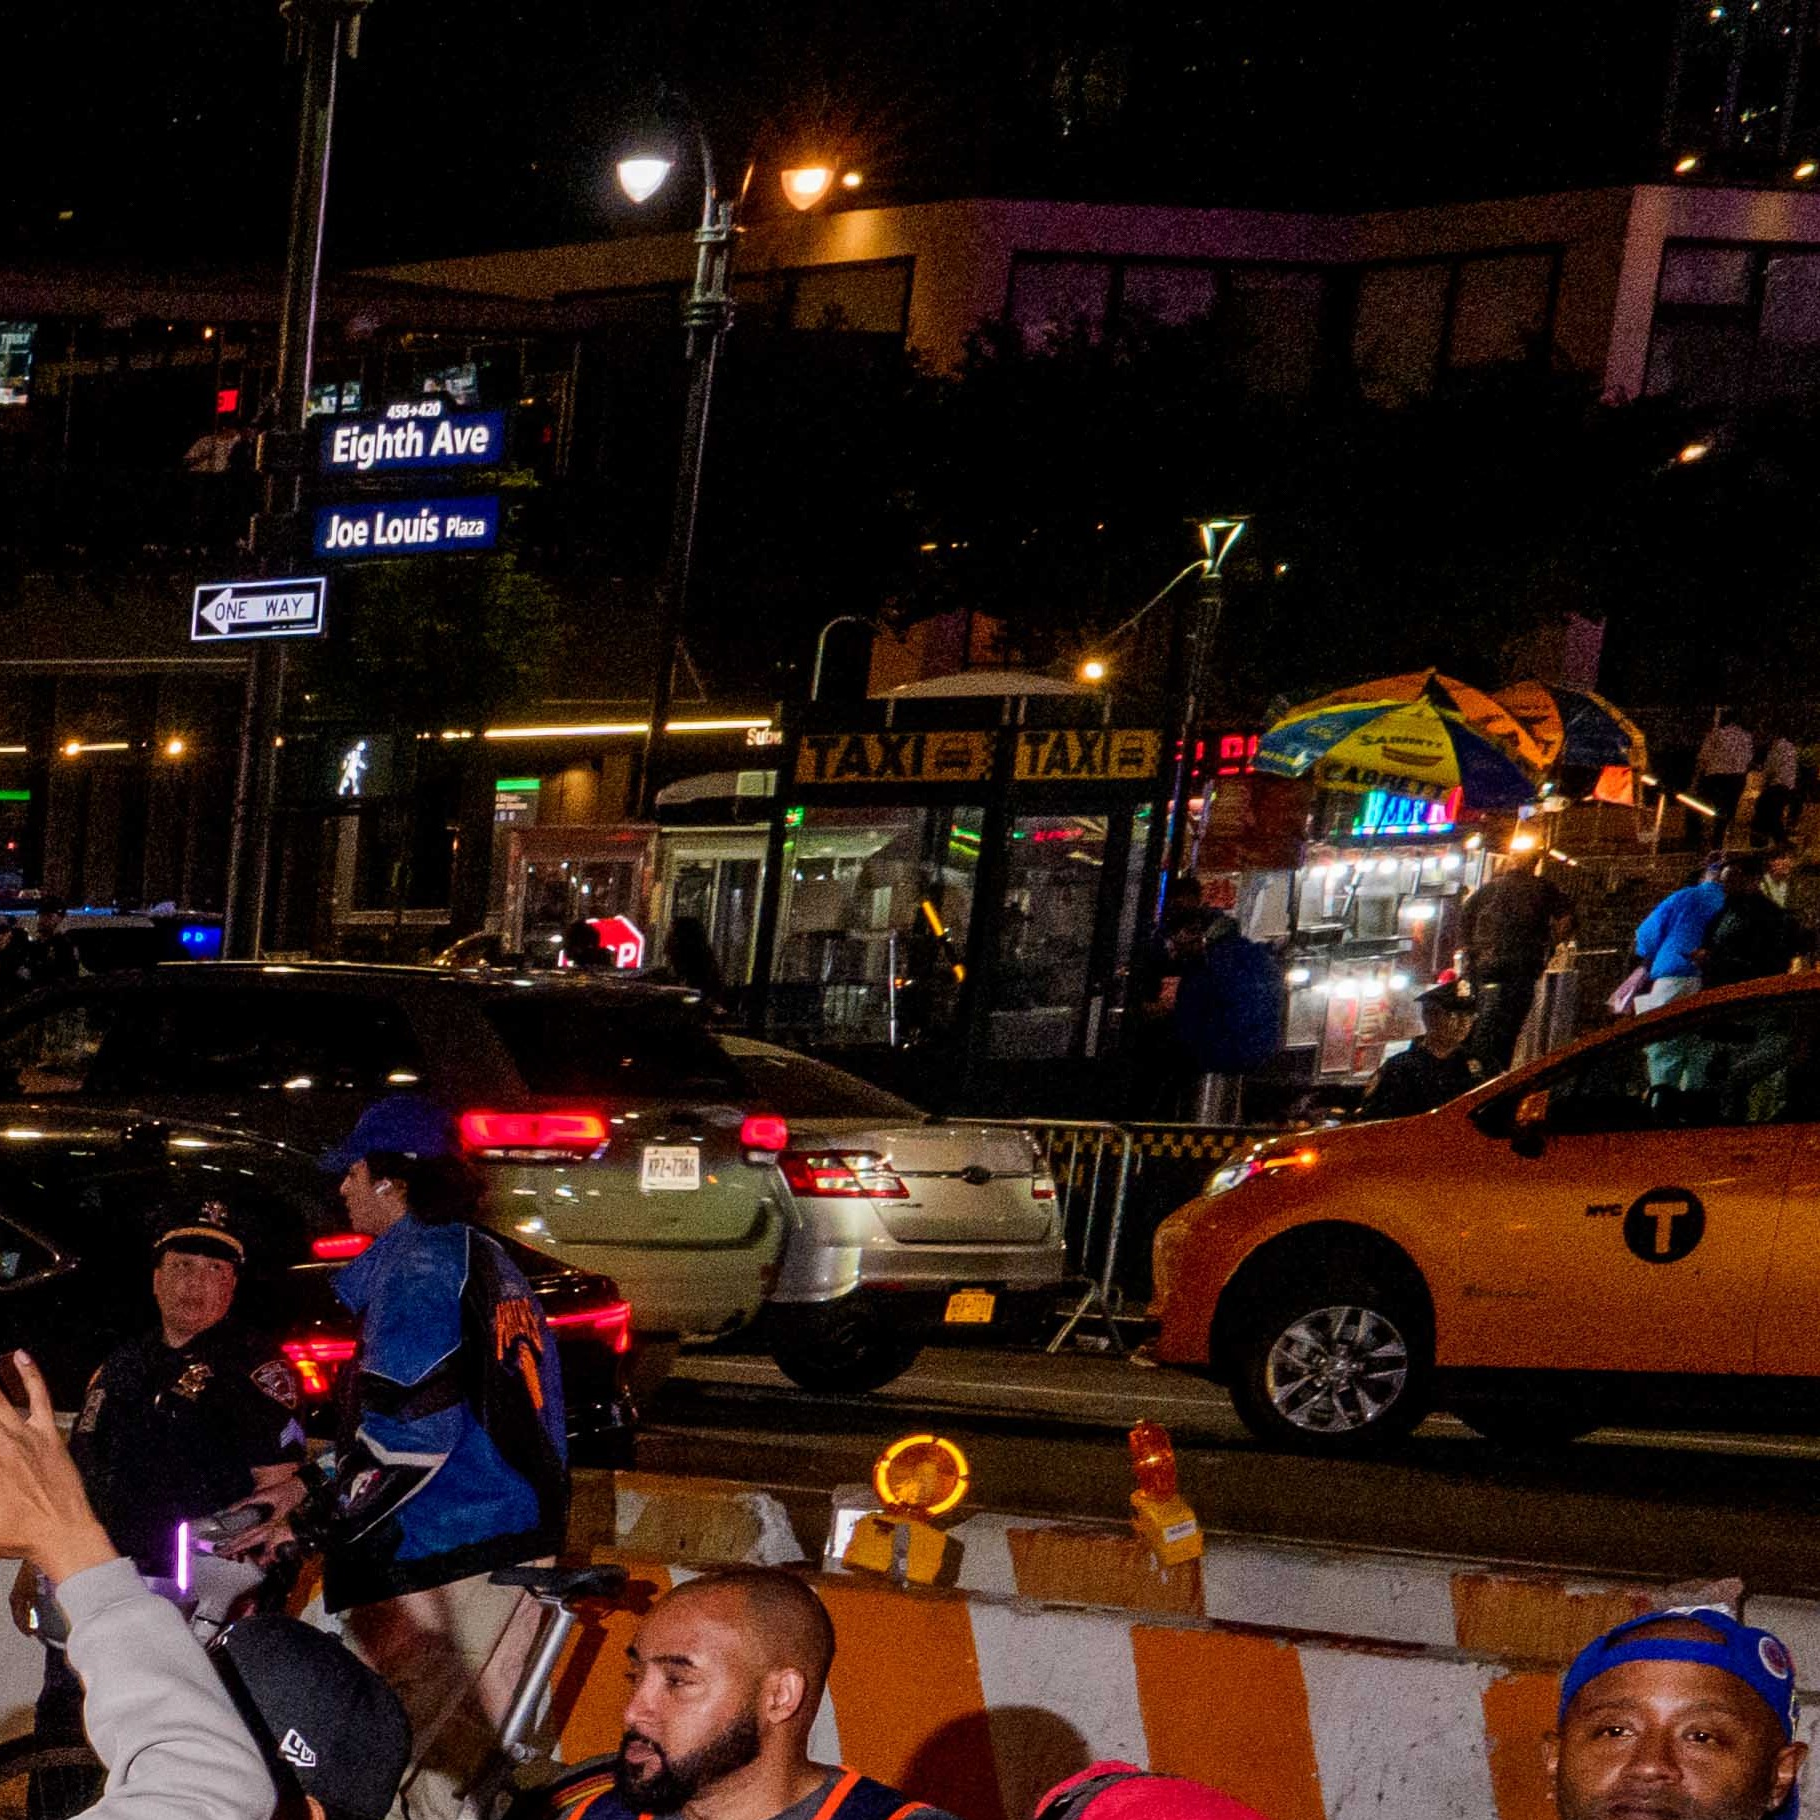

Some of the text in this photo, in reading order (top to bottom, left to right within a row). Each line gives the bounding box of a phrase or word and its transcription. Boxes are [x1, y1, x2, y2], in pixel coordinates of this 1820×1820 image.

[332, 420, 490, 470] Eighth Ave
[325, 508, 485, 549] Joe Louis Plaza
[214, 596, 304, 621] ONE WAY
[805, 732, 1112, 778] TAXI TAXI
[1585, 1203, 1623, 1218] NYC
